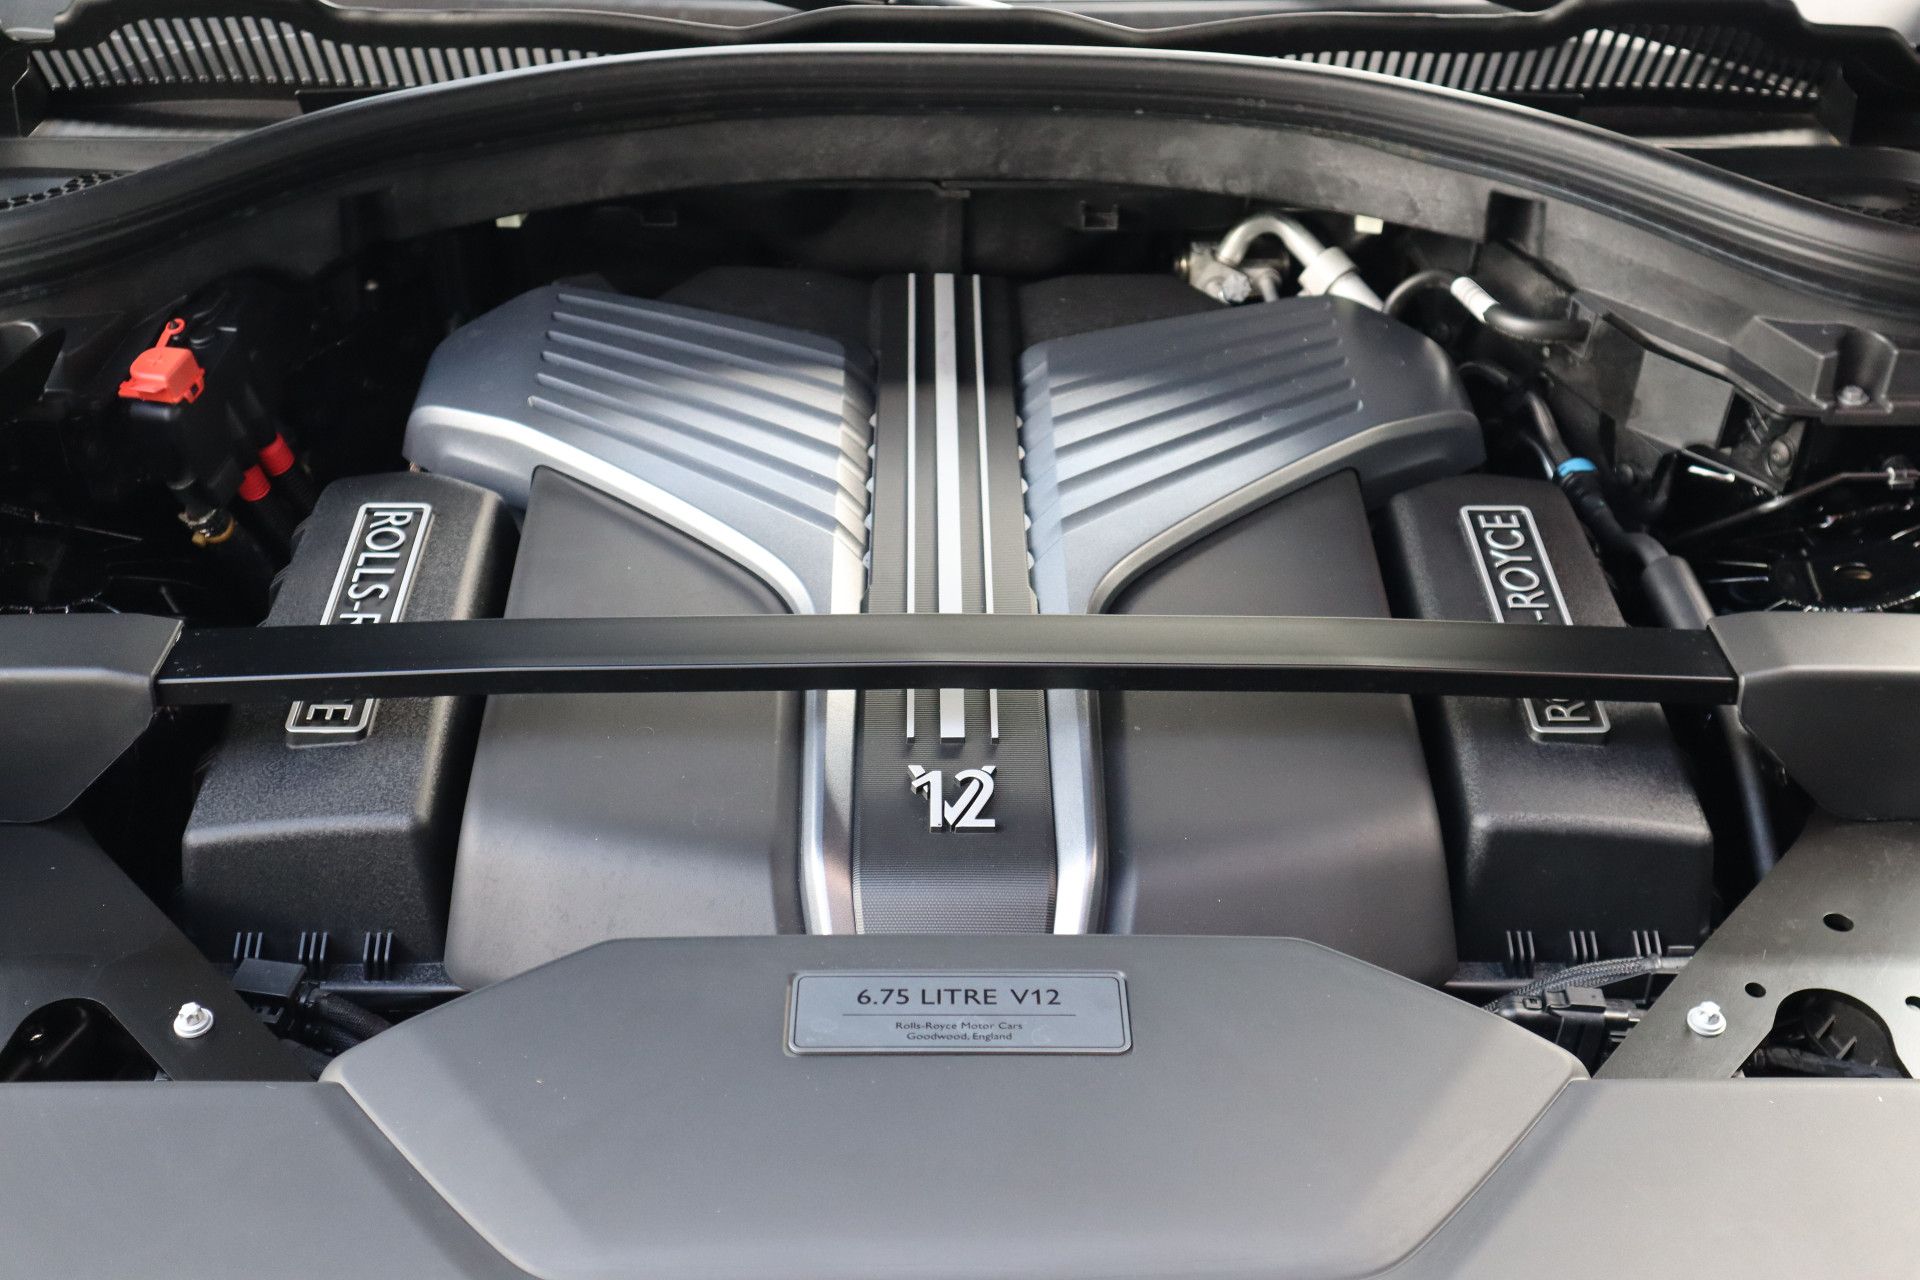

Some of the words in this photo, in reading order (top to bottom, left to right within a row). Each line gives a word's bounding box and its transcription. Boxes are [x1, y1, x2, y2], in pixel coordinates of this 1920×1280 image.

[306, 511, 414, 721] ROLLS-RE
[1477, 514, 1591, 722] R-ROYCE
[856, 988, 910, 1005] 6.75
[921, 988, 998, 1005] LITRE
[1010, 988, 1062, 1005] V12
[895, 1021, 958, 1031] Rolls-Royce
[961, 1021, 994, 1030] Motor
[998, 1021, 1023, 1030] Cars
[906, 1032, 970, 1041] Goodwood,
[972, 1032, 1013, 1042] England
